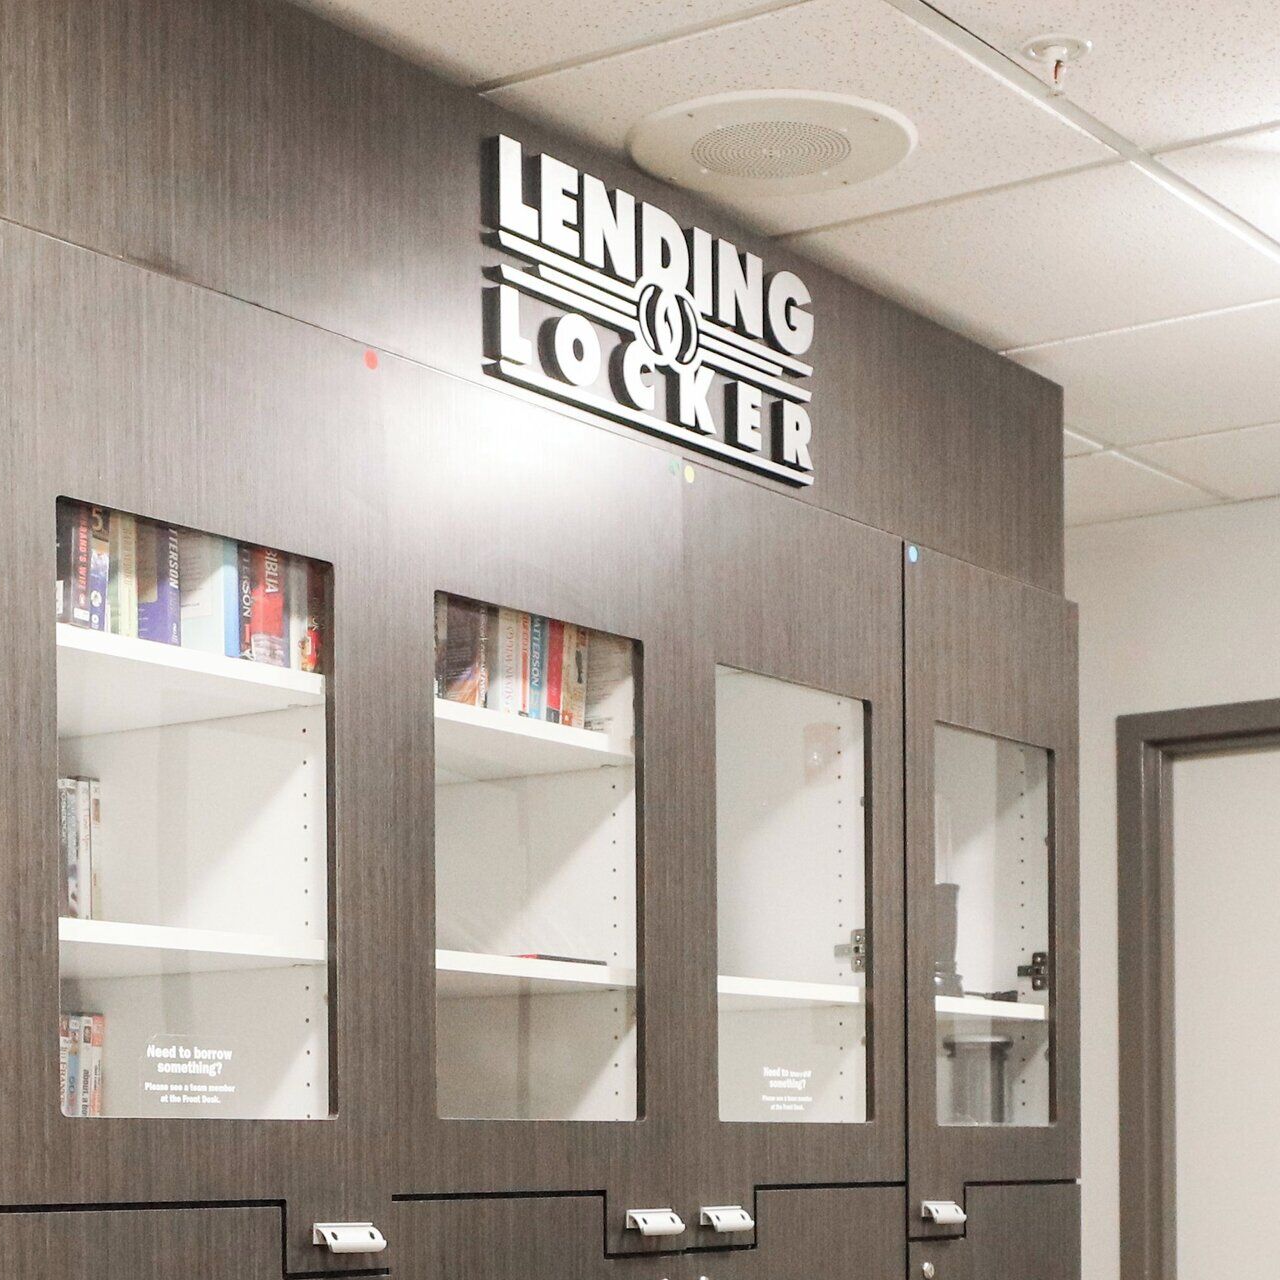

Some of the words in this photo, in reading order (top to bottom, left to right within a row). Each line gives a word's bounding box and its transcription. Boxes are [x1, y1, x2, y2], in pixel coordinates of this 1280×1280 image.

[496, 133, 815, 356] LENDING
[496, 283, 814, 471] LOCKER
[531, 617, 541, 687] ATTERSON
[146, 1044, 176, 1058] Need
[178, 1045, 192, 1059] to
[193, 1046, 233, 1060] borrow
[157, 1060, 223, 1077] something?
